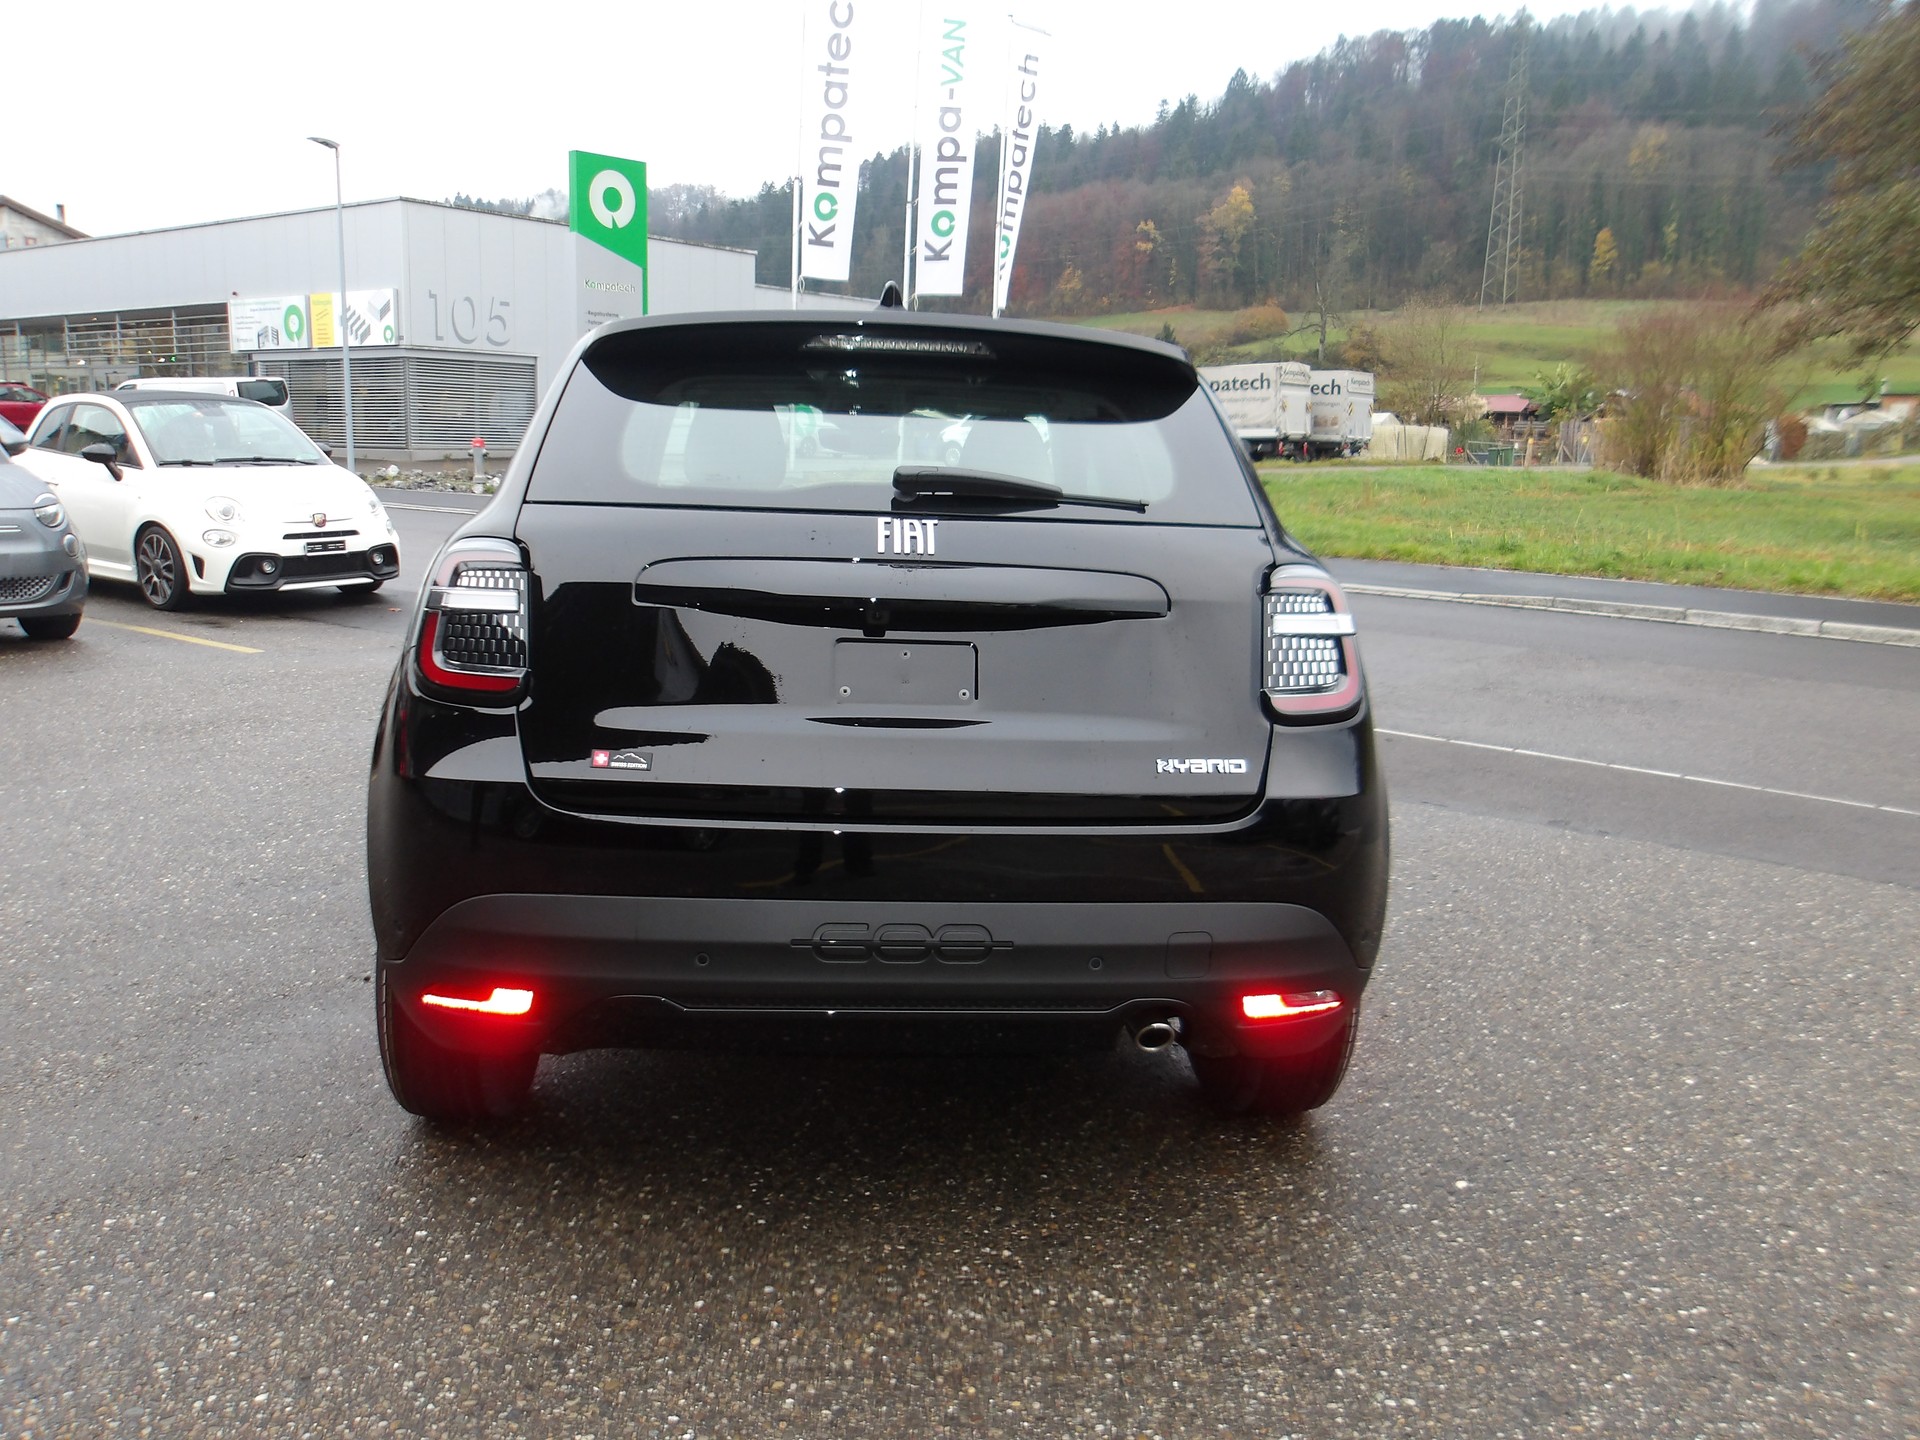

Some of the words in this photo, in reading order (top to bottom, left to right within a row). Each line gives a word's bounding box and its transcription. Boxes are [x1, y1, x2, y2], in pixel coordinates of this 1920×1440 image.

[924, 18, 967, 262] Kompa-VAN
[427, 288, 511, 347] 105
[1310, 379, 1341, 395] ech
[877, 517, 938, 555] FIAT
[1156, 758, 1247, 774] HYBRID
[811, 922, 995, 965] 600
